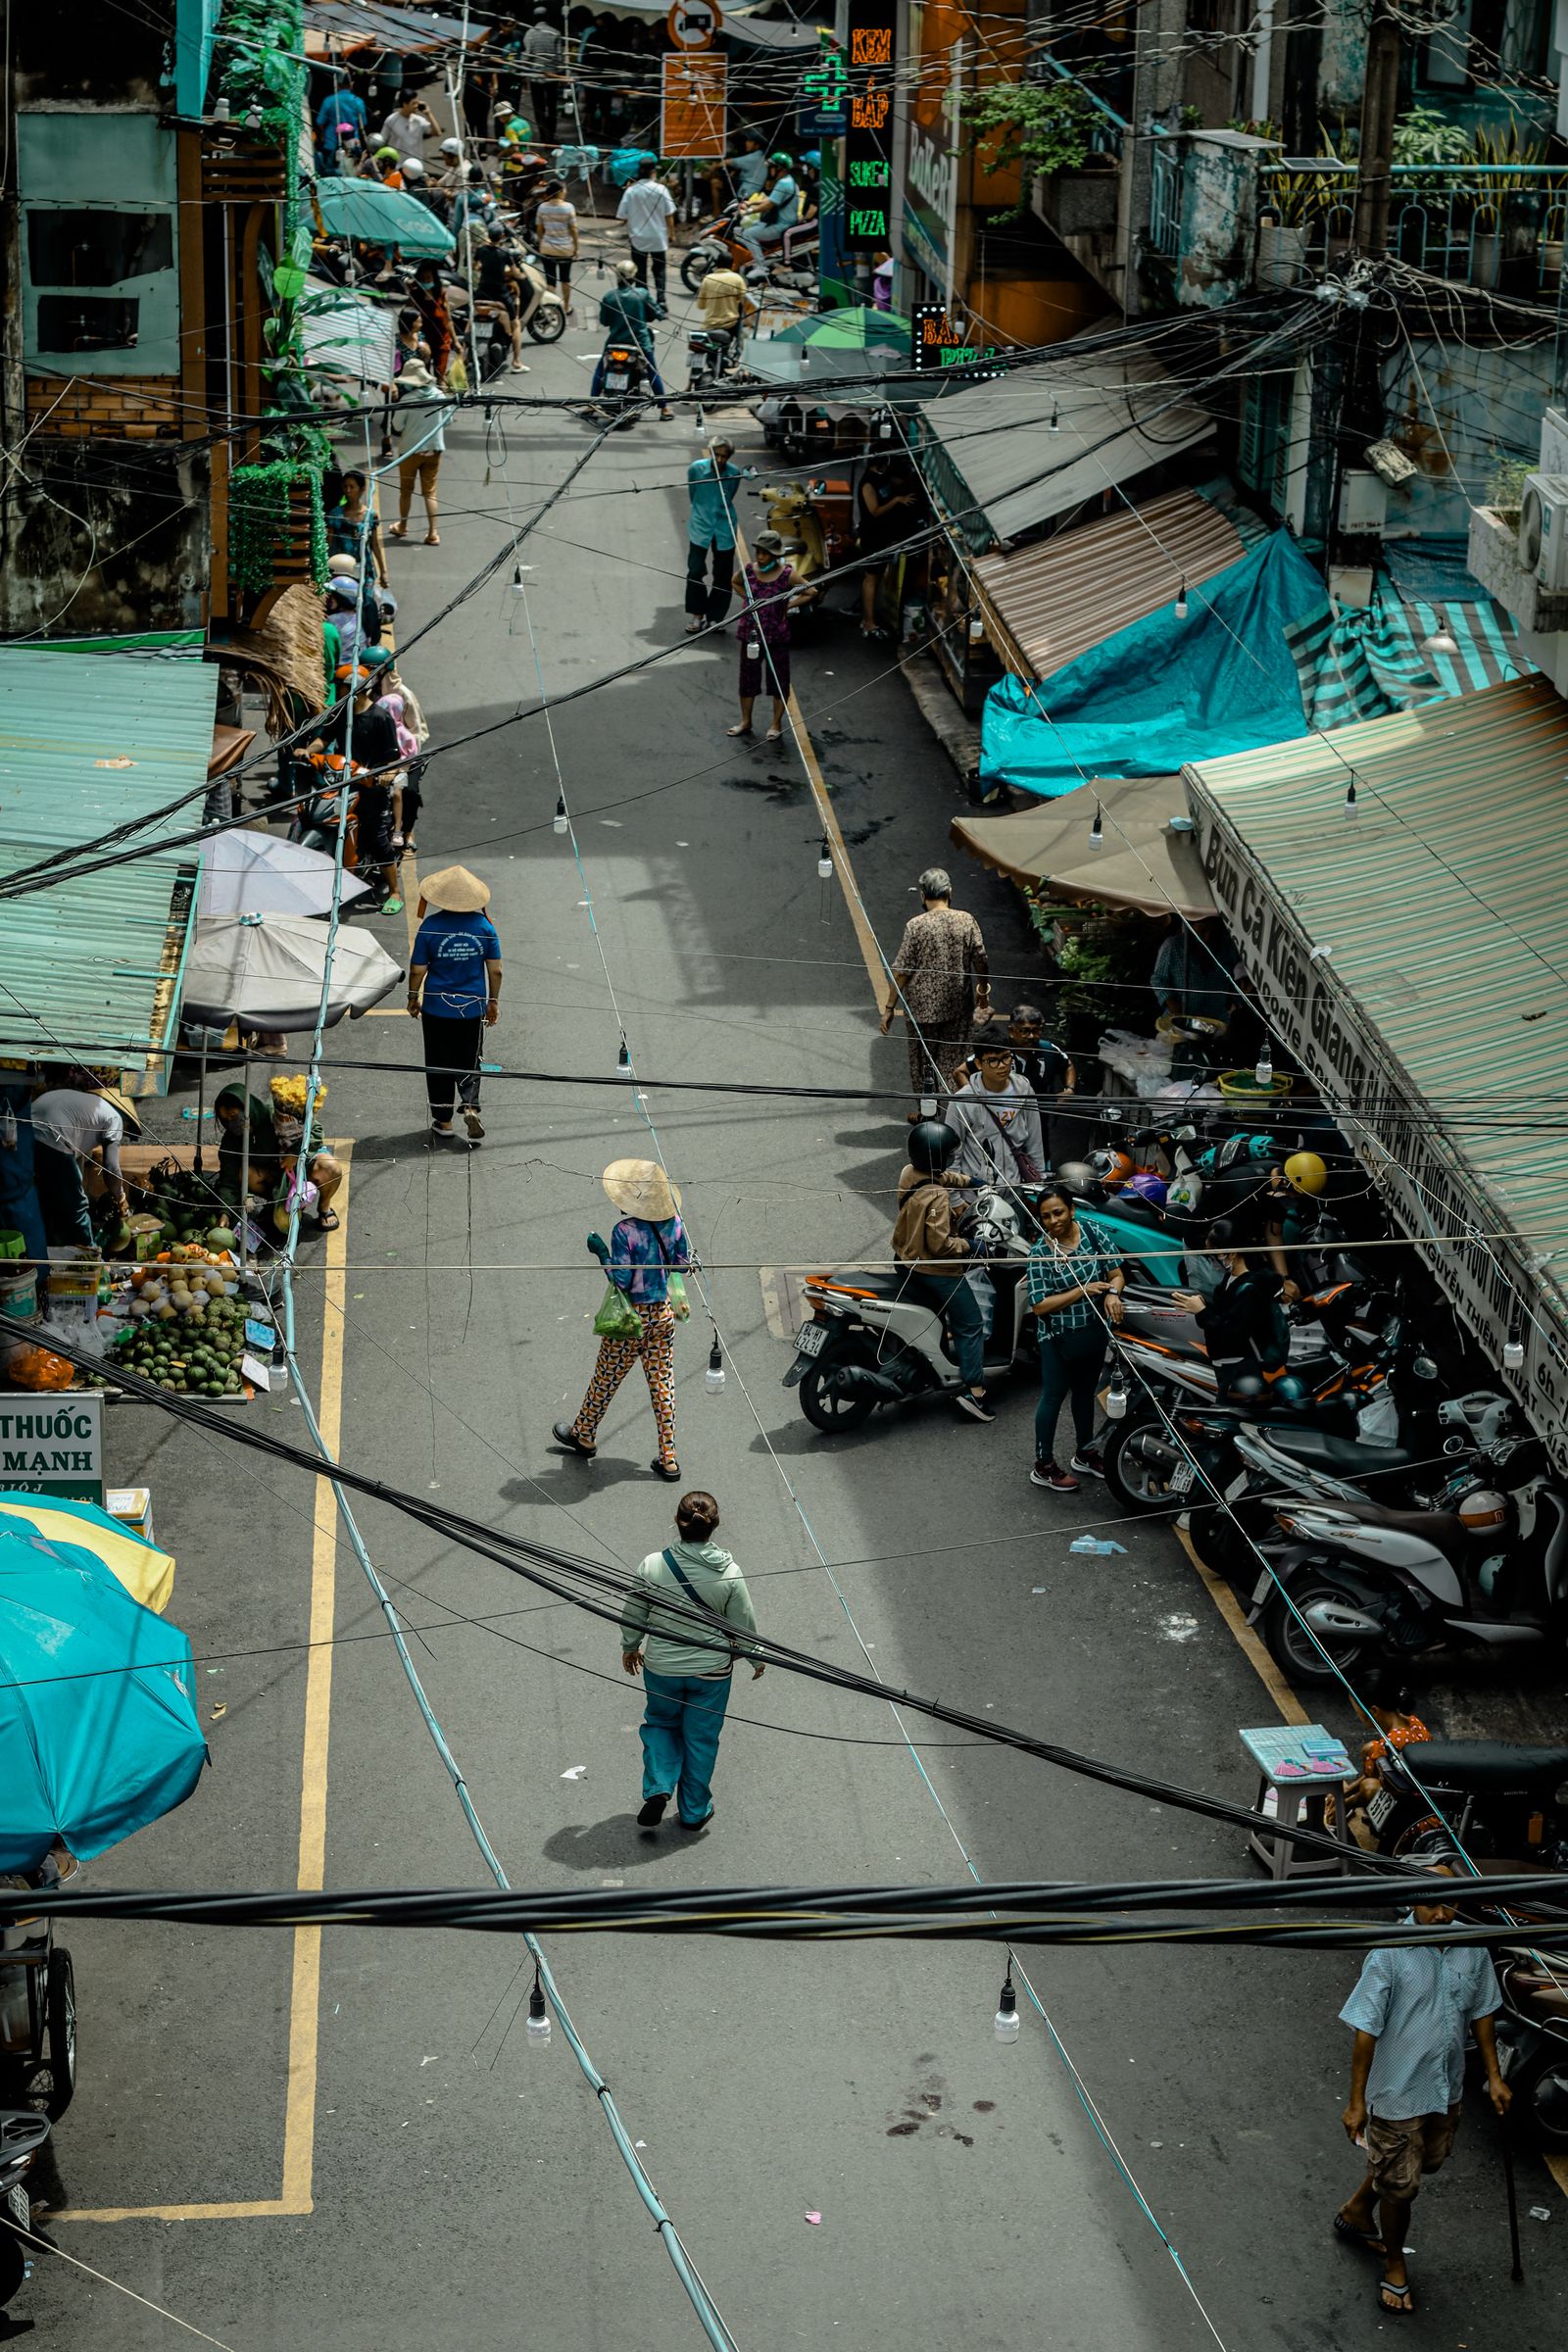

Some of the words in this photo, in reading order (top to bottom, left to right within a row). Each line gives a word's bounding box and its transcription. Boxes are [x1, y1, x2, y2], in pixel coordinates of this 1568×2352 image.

[852, 28, 891, 64] KEM
[850, 210, 885, 235] PIZZA
[1205, 824, 1240, 915] Bún
[1242, 876, 1267, 955] Cá
[1267, 914, 1308, 1020] Kiên
[1311, 981, 1367, 1111] Giang
[1251, 957, 1301, 1050] Noodle
[1420, 1231, 1465, 1306] NGUYỄN
[1466, 1297, 1498, 1356] THIỆN
[1539, 1363, 1555, 1400] 6h
[0, 1406, 92, 1439] THUỐC
[3, 1451, 93, 1476] MẠNH
